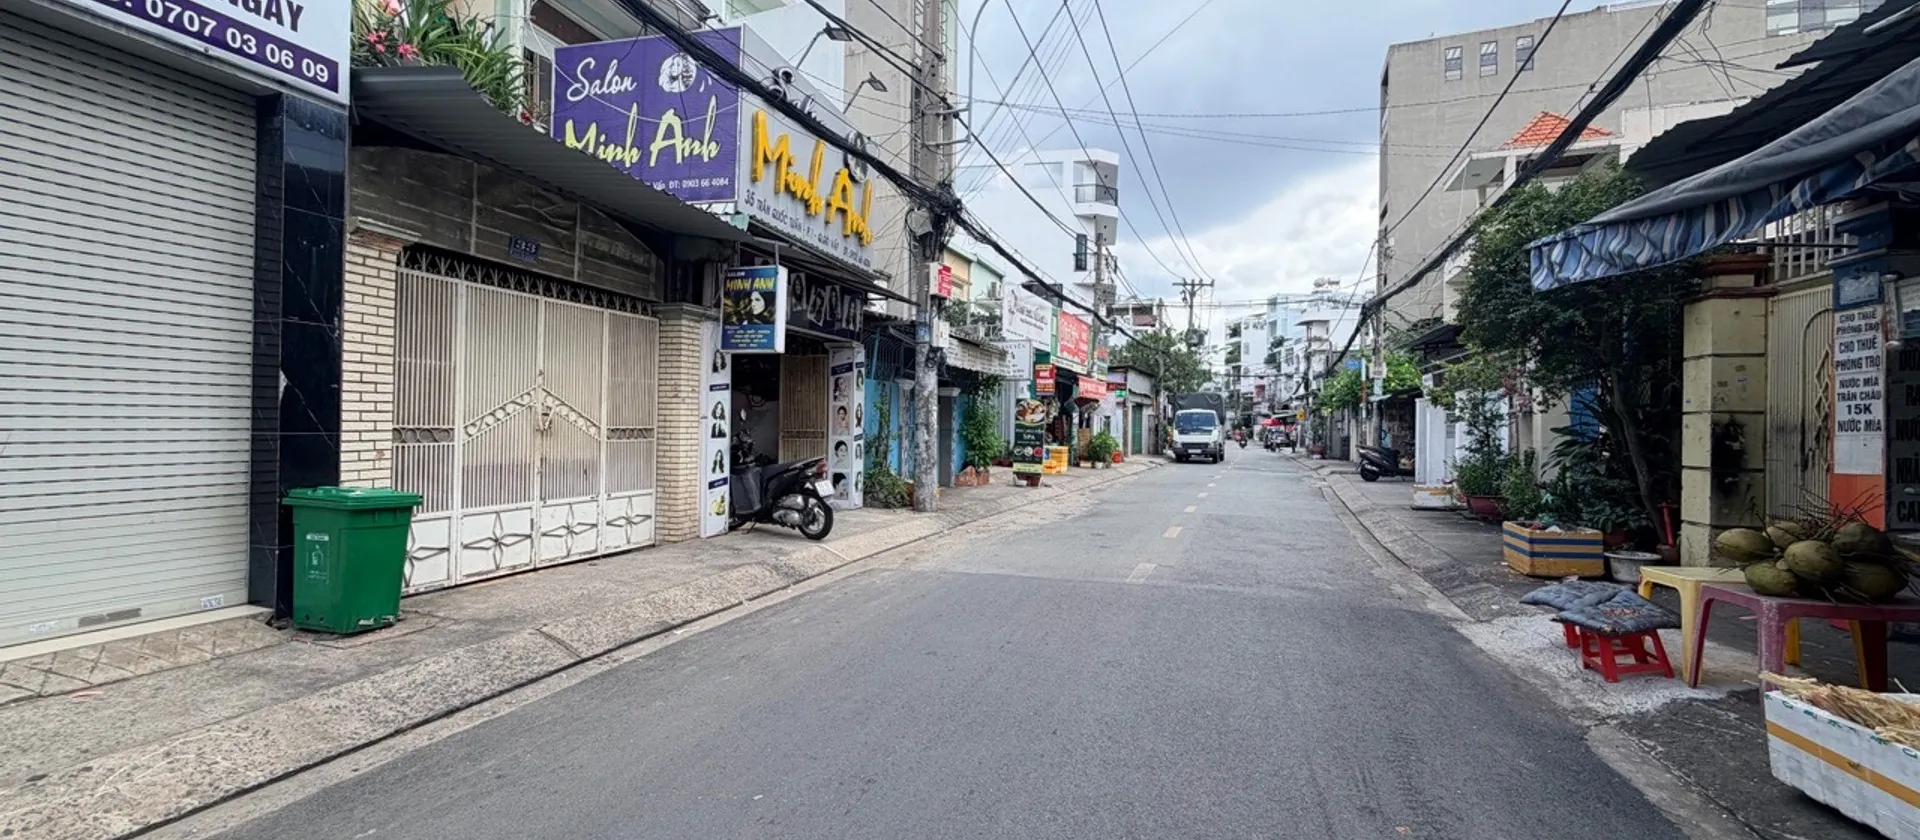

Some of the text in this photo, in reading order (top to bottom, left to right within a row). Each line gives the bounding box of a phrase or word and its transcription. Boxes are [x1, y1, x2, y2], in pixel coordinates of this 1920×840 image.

[146, 0, 329, 83] 0707 03 06 09
[566, 57, 637, 102] Salon
[565, 94, 722, 169] Minh Anh
[751, 108, 873, 248] Minh Anh
[744, 188, 755, 207] 35
[1839, 308, 1877, 323] CHO THUÊ
[1836, 323, 1862, 335] PHÒNG
[1839, 335, 1877, 354] CHO THUÊ
[1836, 355, 1880, 371] PHÒNG TRỌ
[1839, 377, 1861, 389] NƯỚC
[1846, 404, 1873, 415] 15K
[1838, 418, 1861, 433] NƯỚC
